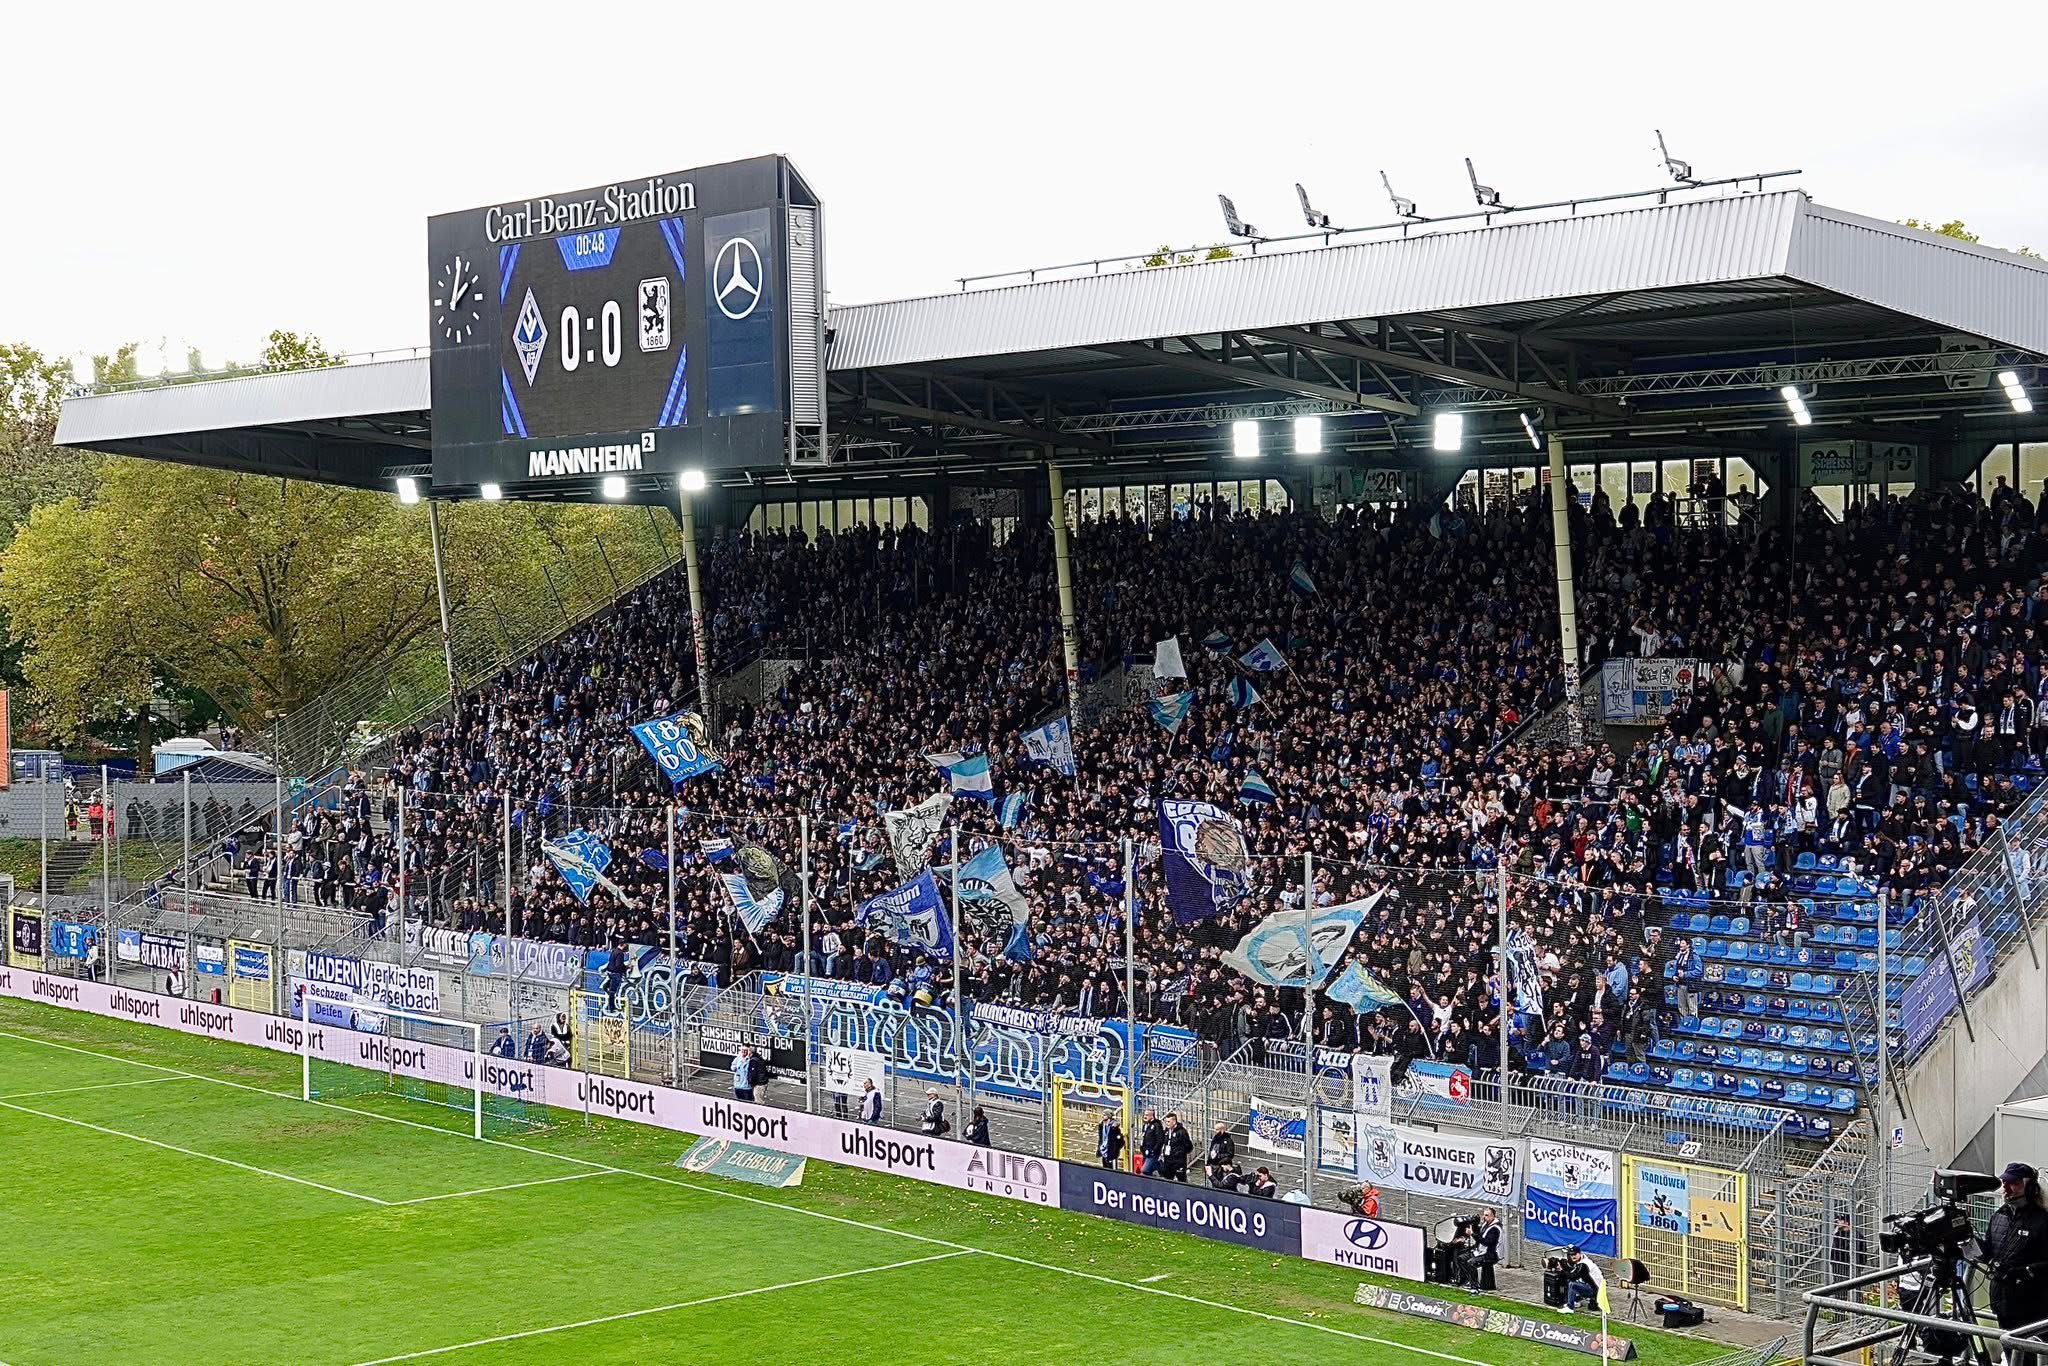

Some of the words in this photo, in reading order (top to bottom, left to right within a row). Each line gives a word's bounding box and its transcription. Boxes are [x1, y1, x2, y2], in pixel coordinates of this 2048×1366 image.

[485, 179, 697, 243] Carl-Benz-Stadion
[576, 232, 605, 257] 00:48
[560, 300, 622, 372] 0:0
[646, 335, 664, 346] 1860
[528, 444, 642, 477] MANNHEIM
[642, 720, 680, 748] 18
[657, 738, 697, 770] 60
[307, 953, 361, 989] HADERN
[32, 976, 80, 1003] uhlsport
[310, 984, 348, 1002] Sechzger
[110, 989, 161, 1019] uhlsport
[180, 1003, 234, 1033] uhlsport
[702, 1025, 741, 1043] SINSHEIM
[743, 1031, 773, 1049] BLEIBT
[774, 1037, 794, 1051] DEM
[359, 1037, 426, 1070] uhlsport
[1317, 1050, 1350, 1067] MIB
[702, 1101, 788, 1142] uhlsport
[726, 1150, 789, 1174] EICHBAUM
[841, 1127, 936, 1172] uhlsport
[1403, 1141, 1475, 1165] KASINGER
[1532, 1145, 1611, 1172] Engelsberger
[1681, 1143, 1697, 1155] 23
[967, 1149, 1047, 1186] AUTO
[1404, 1162, 1475, 1190] LÖWEN
[1641, 1170, 1686, 1190] ISARLÖWEN
[1093, 1181, 1128, 1210] Der
[1132, 1196, 1181, 1221] neue
[1186, 1200, 1248, 1236] IONIQ
[1253, 1212, 1266, 1238] 9
[1525, 1199, 1615, 1237] Buchbach
[1649, 1214, 1679, 1232] 1860
[1335, 1248, 1399, 1274] HYUNDAI
[1400, 1295, 1445, 1317] Scholz
[1534, 1323, 1580, 1346] Scholz
